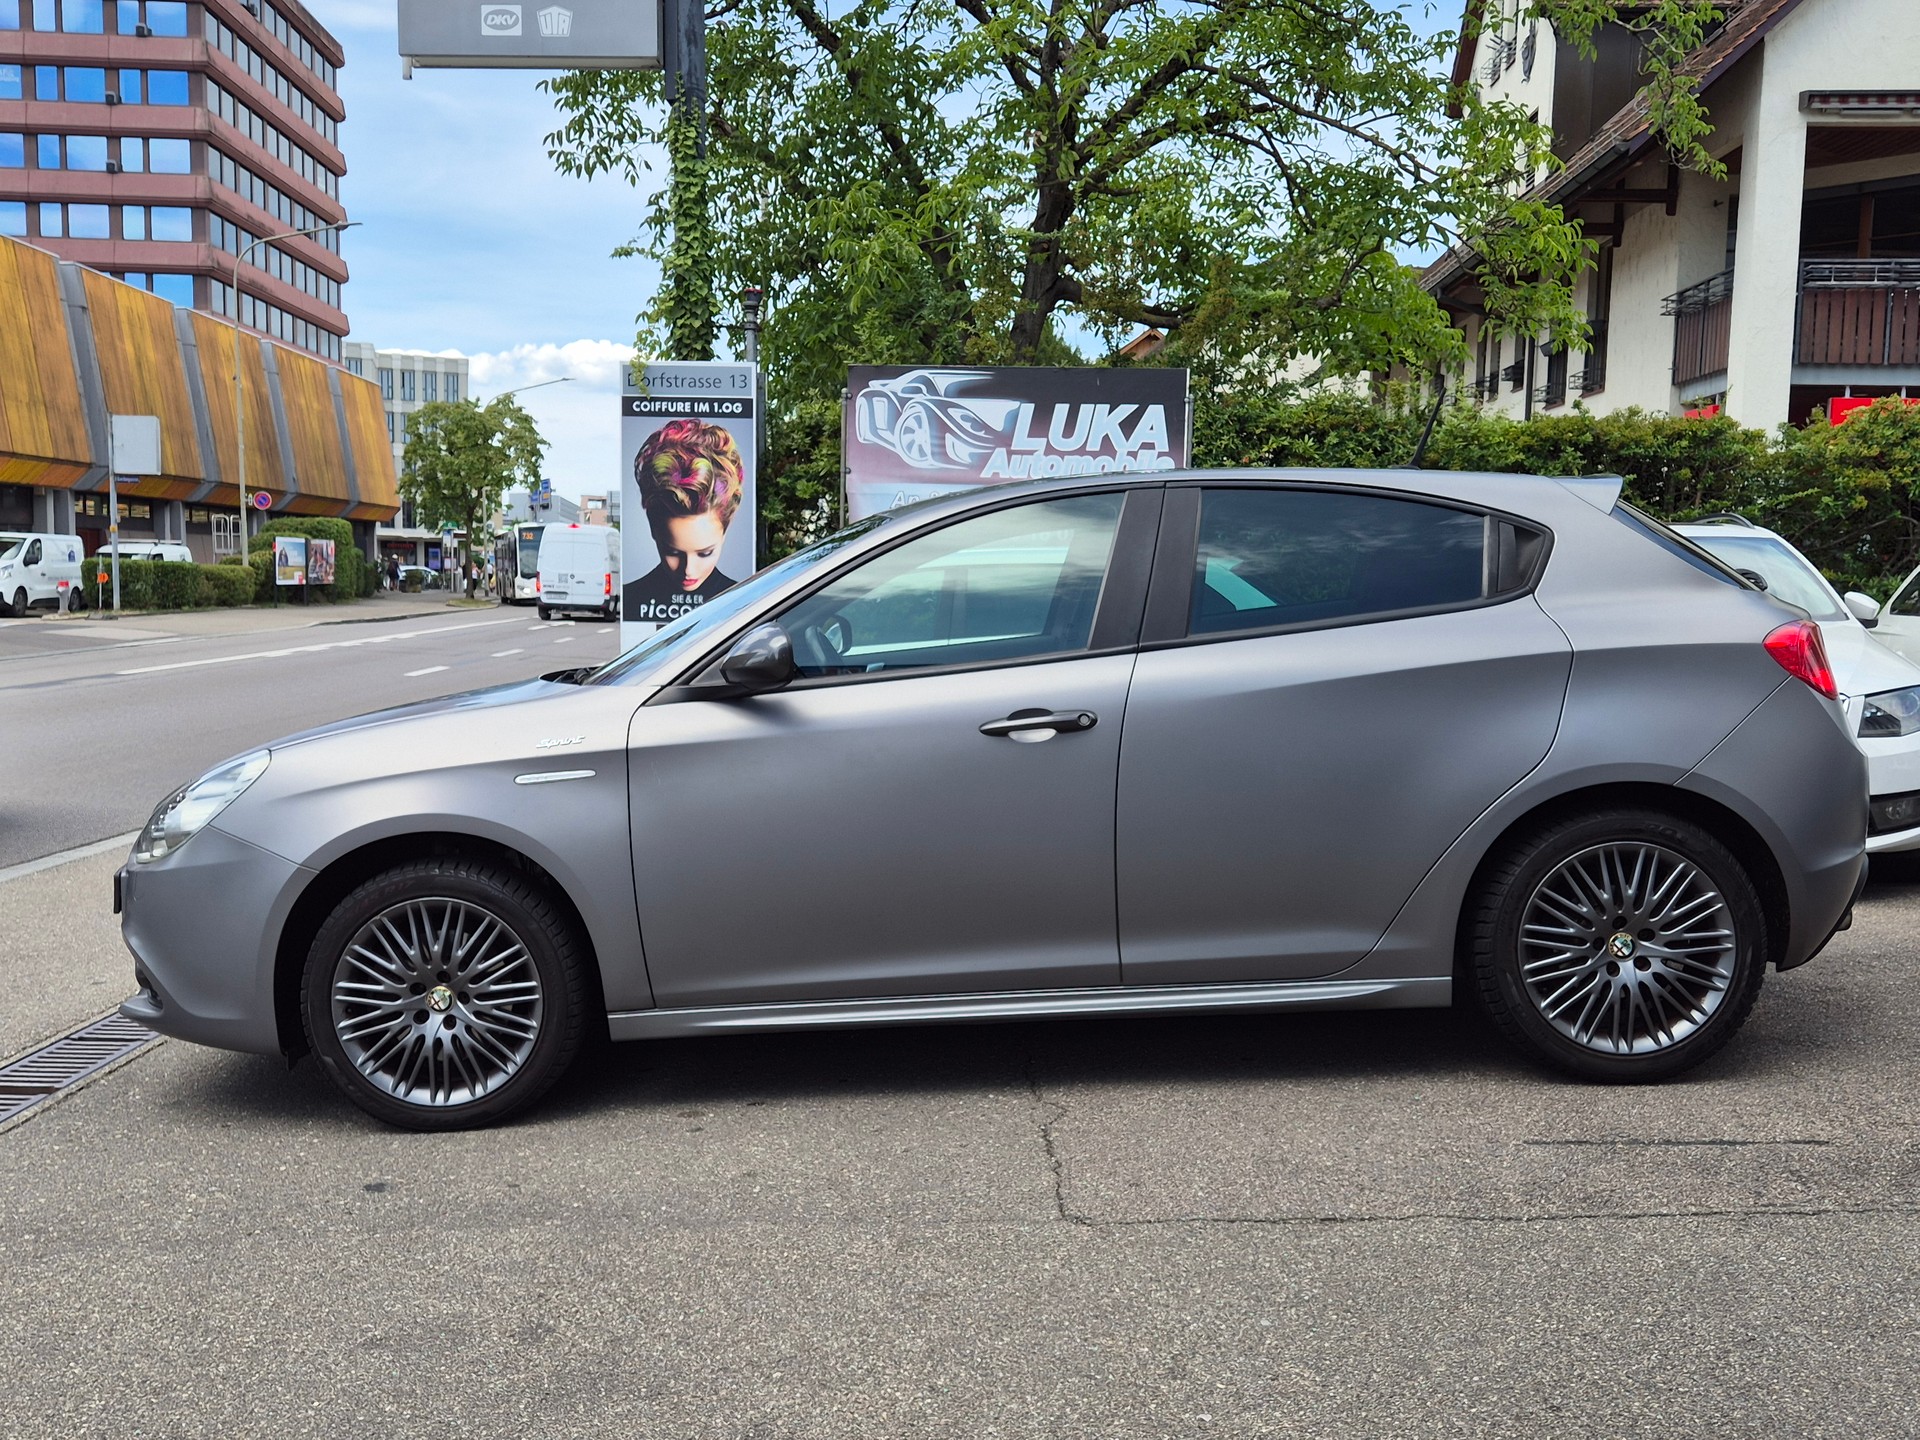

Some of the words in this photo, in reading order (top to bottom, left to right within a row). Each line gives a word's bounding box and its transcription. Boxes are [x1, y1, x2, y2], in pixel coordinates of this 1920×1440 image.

[486, 14, 517, 25] DKV
[539, 6, 571, 35] UTA
[627, 371, 722, 389] Dorfstrasse
[729, 373, 748, 389] 13
[632, 401, 691, 412] COIFFURE
[694, 402, 710, 413] IM
[713, 402, 743, 414] 1.OG
[1010, 403, 1170, 452] LUKA
[980, 448, 1176, 479] Automobile
[671, 594, 684, 604] SIE
[685, 594, 692, 604] &
[693, 594, 704, 604] ER
[536, 735, 586, 749] Sprint
